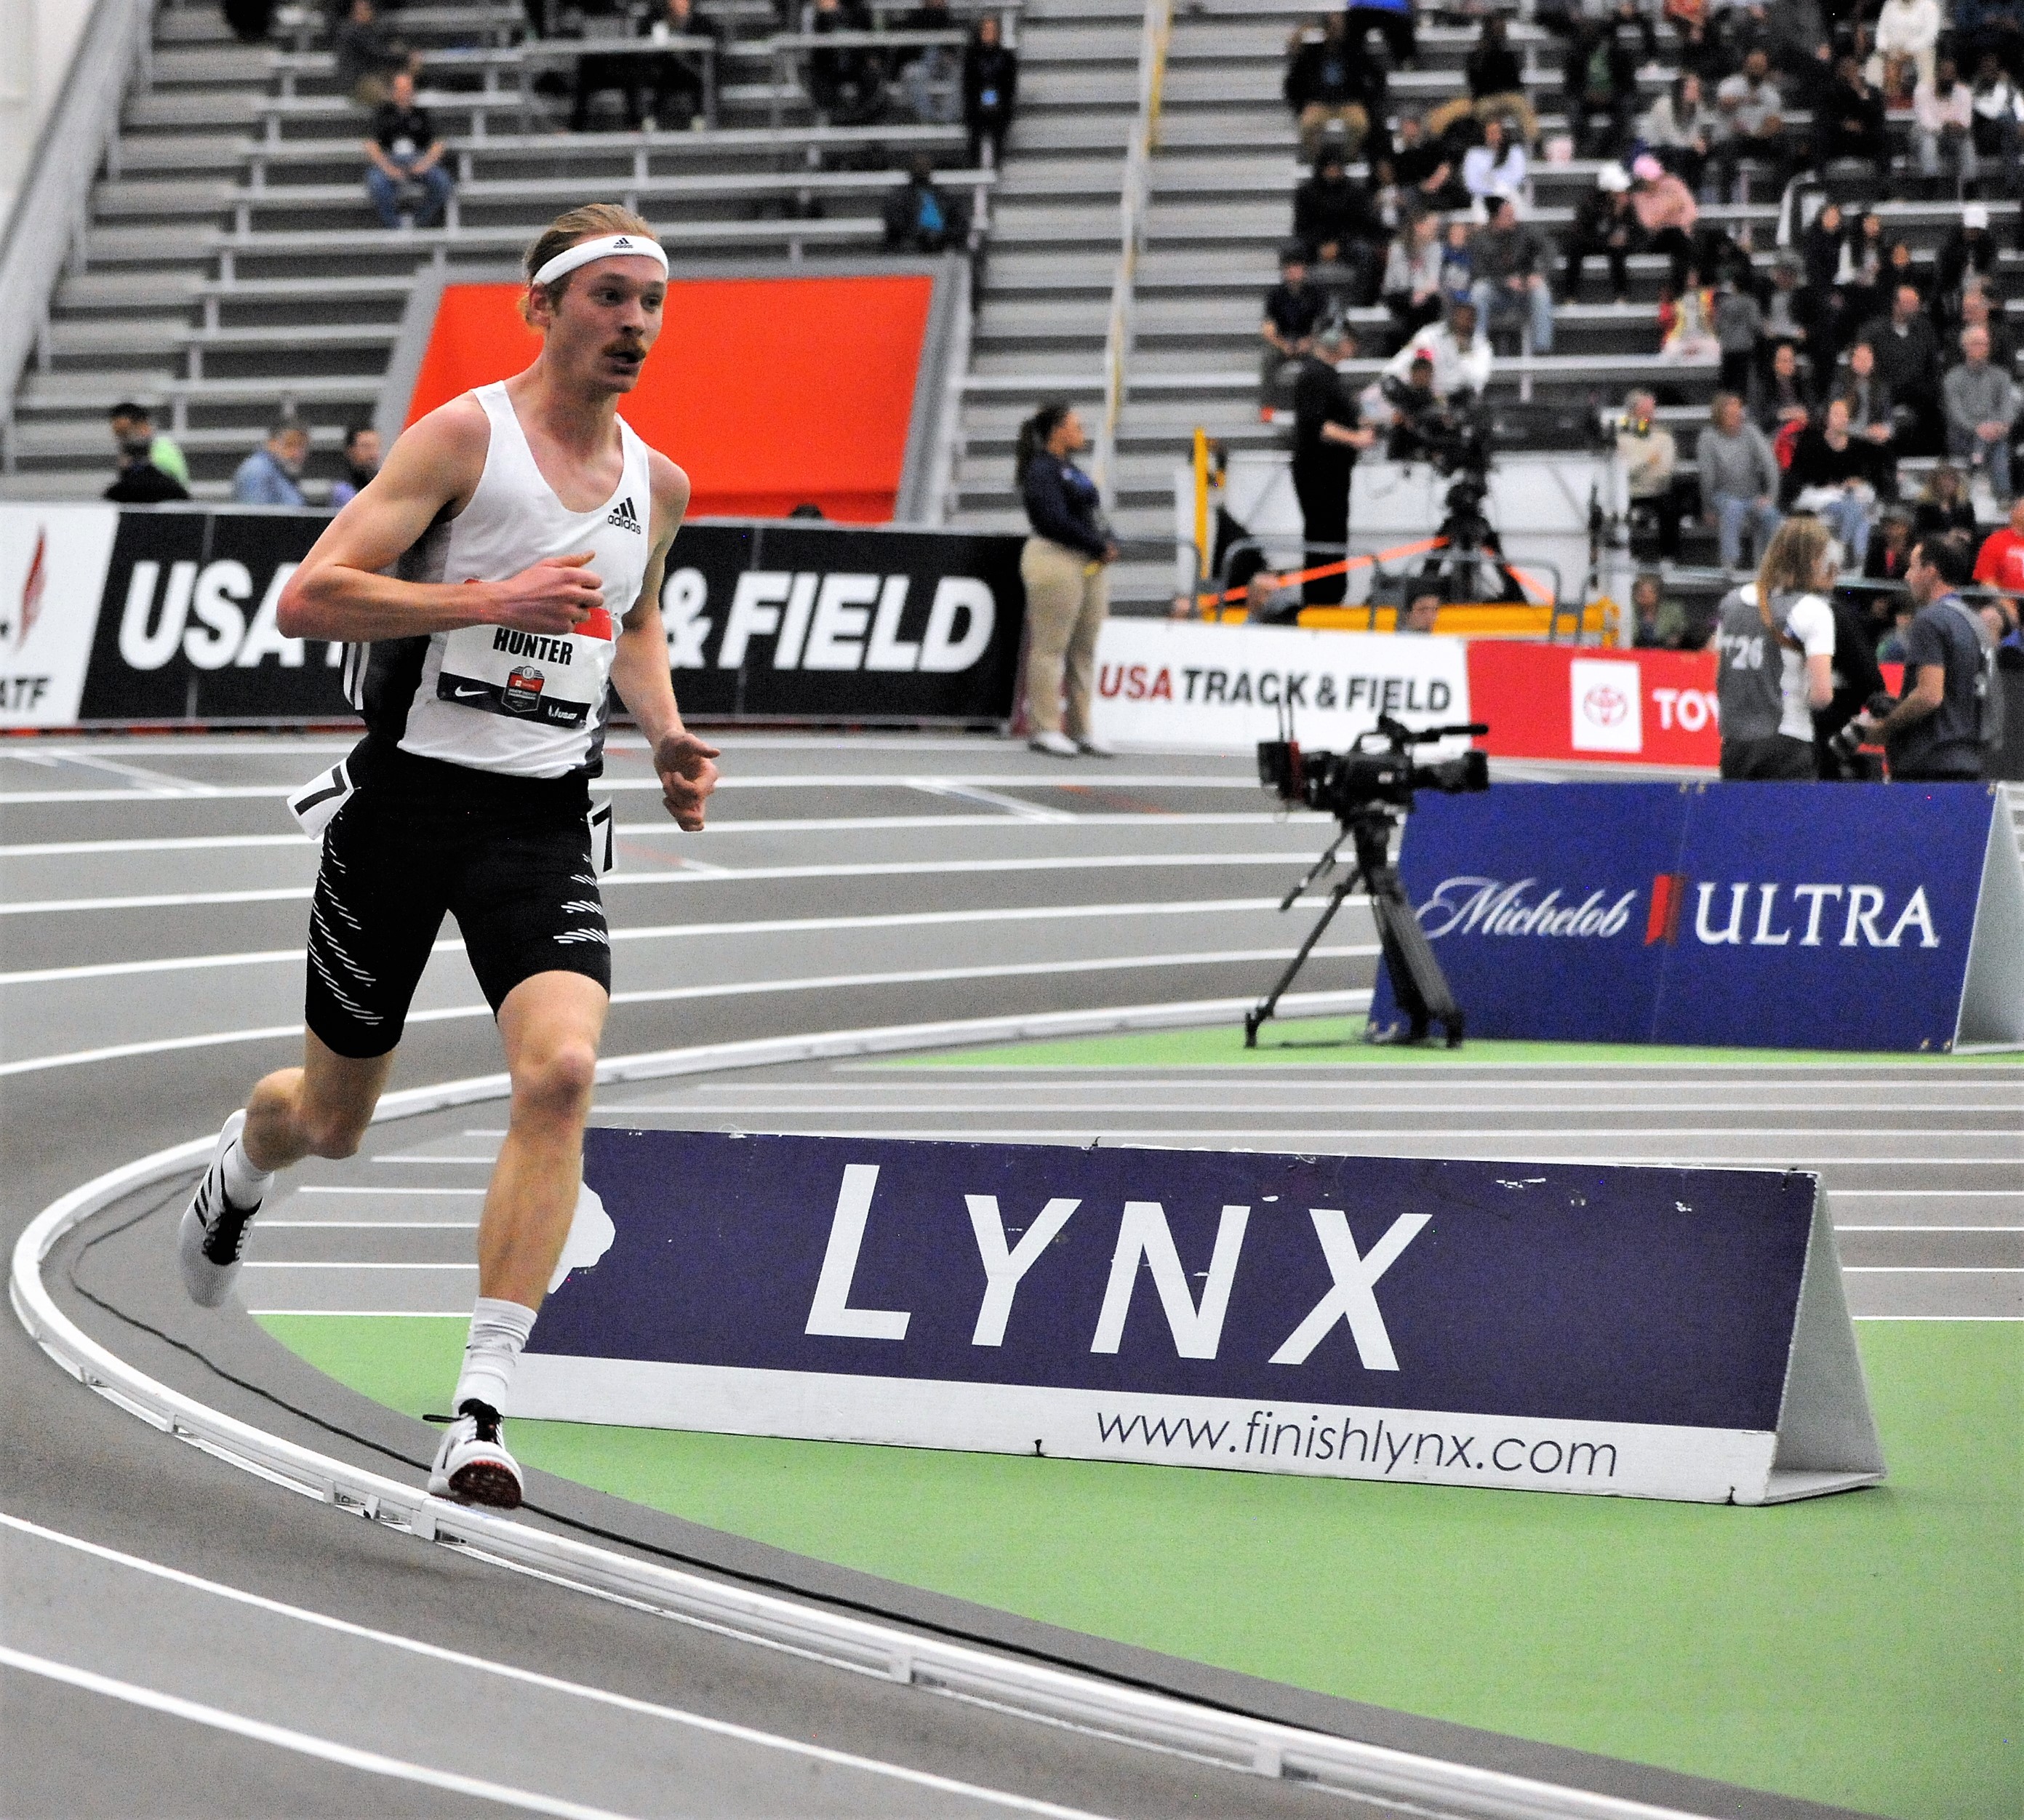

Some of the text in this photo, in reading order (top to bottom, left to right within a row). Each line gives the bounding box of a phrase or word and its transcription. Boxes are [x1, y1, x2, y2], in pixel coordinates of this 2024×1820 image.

[607, 514, 641, 535] adidas
[119, 559, 305, 670] USA
[492, 627, 573, 666] HUNTER
[663, 568, 995, 671] & FIELD
[1099, 665, 1452, 713] USA TRACK & FIELD
[293, 765, 347, 816] 7
[592, 803, 612, 872] 7
[1416, 876, 1940, 948] Michelob ULTRA
[804, 1164, 1433, 1371] LYNX
[1097, 1411, 1617, 1477] www.finishlynx.com
